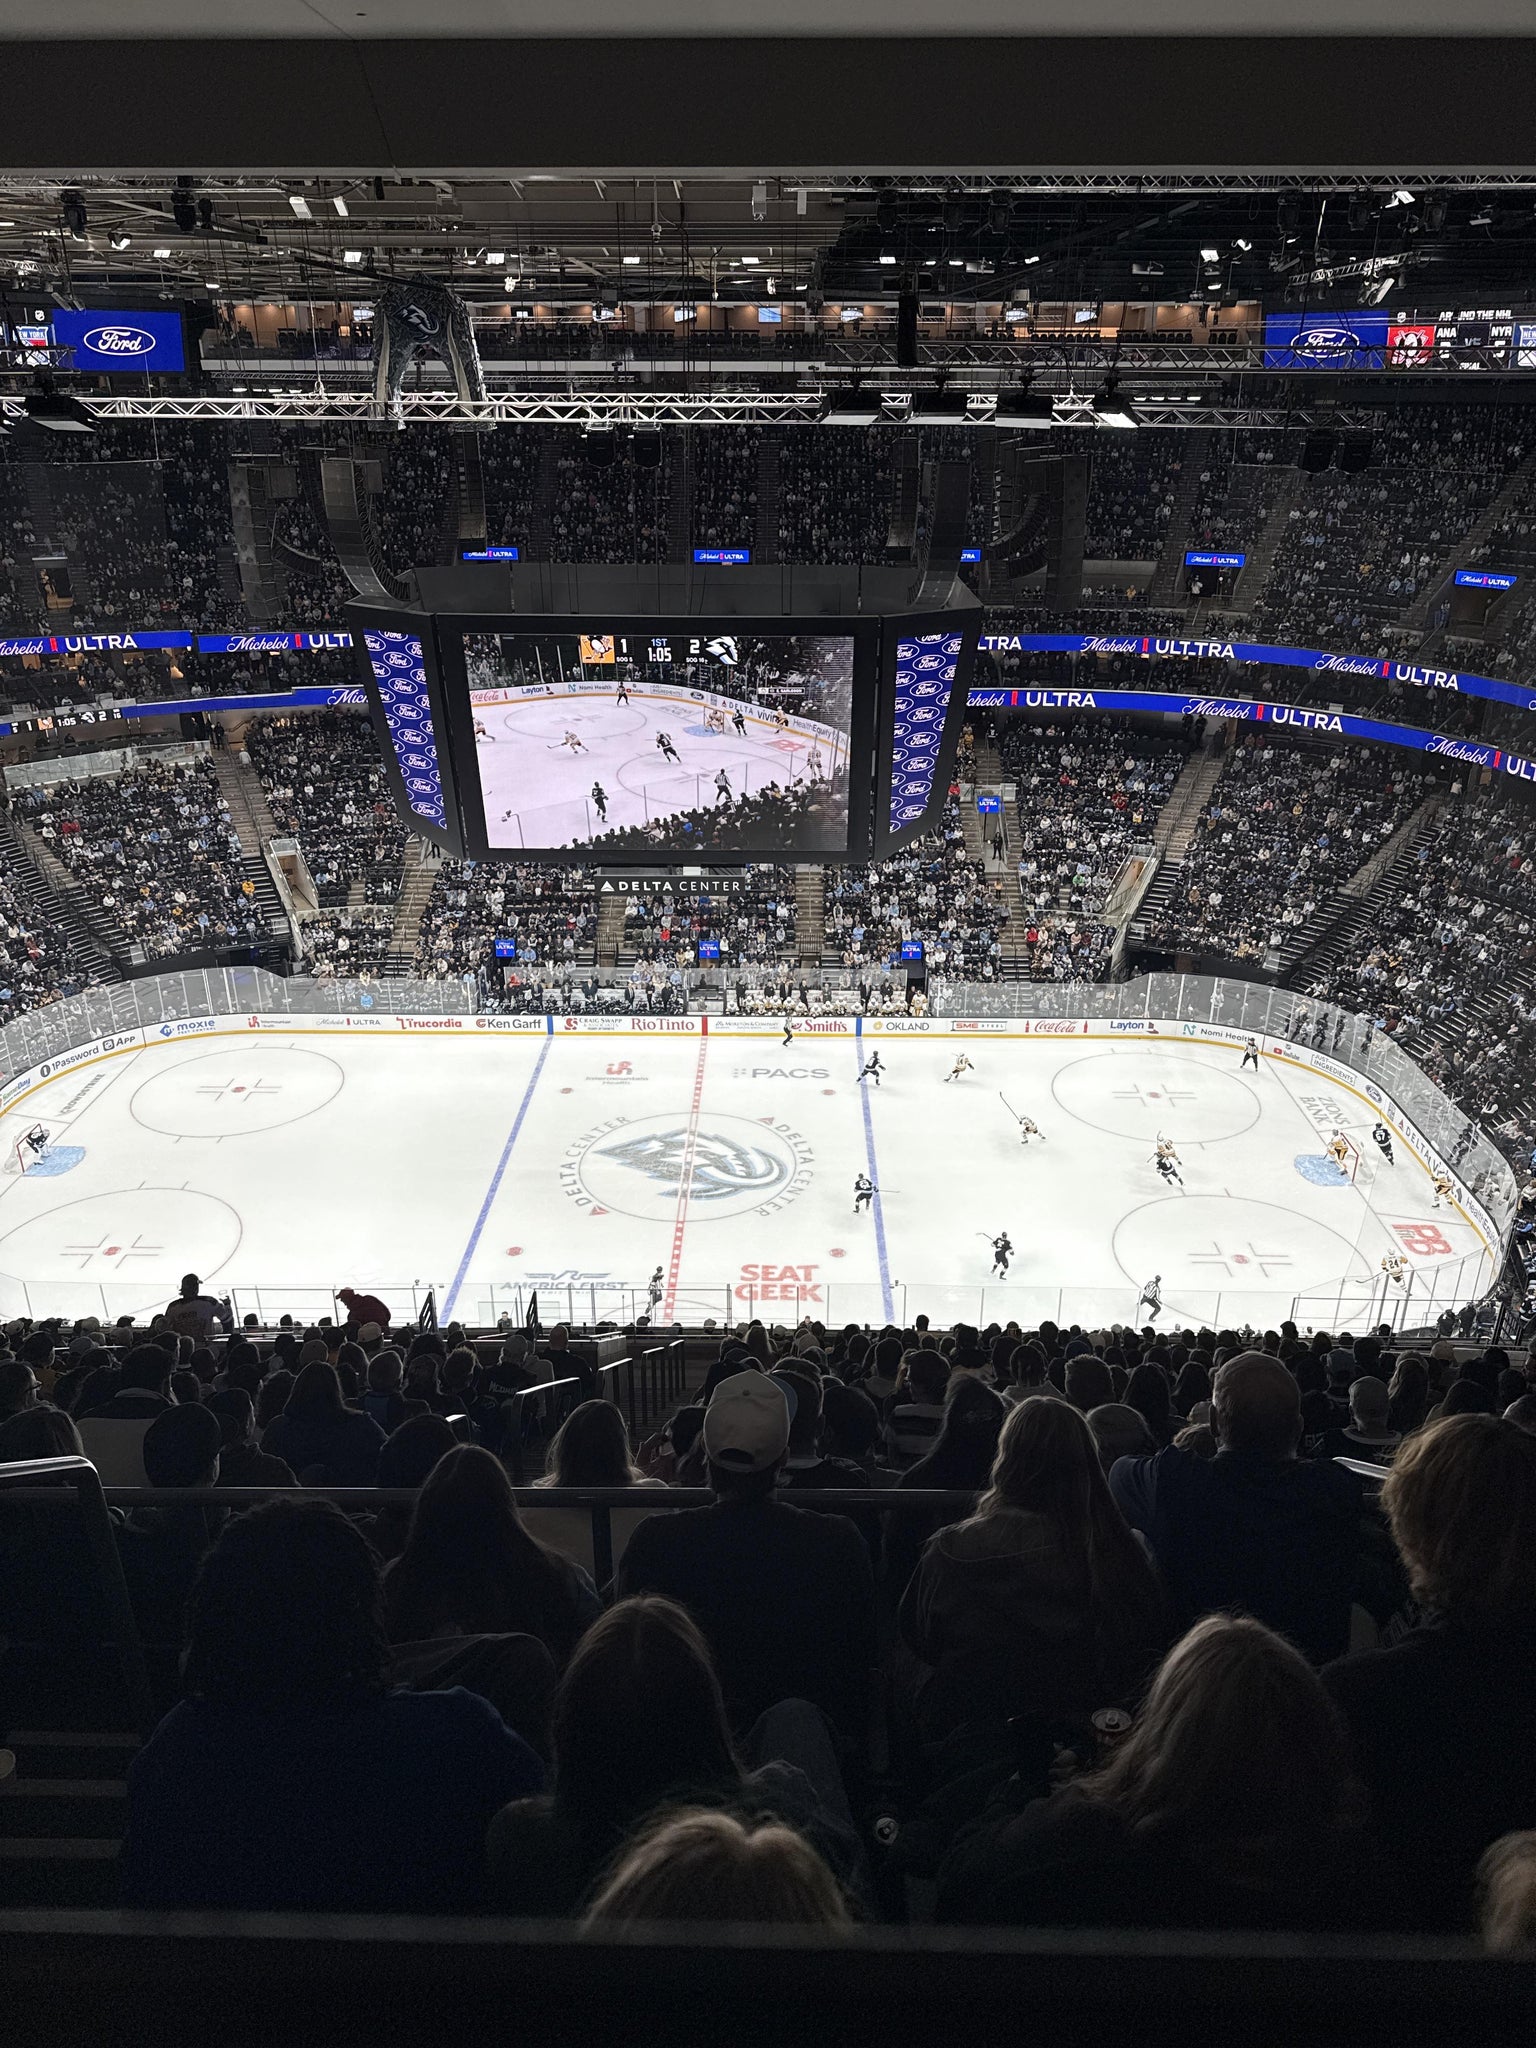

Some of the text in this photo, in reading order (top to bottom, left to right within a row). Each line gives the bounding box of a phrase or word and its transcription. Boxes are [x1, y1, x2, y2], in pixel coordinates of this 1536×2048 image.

[1476, 310, 1494, 320] THE
[1495, 310, 1513, 320] NHL
[28, 330, 44, 338] YORK
[1437, 327, 1456, 338] ANA
[1491, 326, 1512, 336] NYR
[98, 330, 142, 351] Ford
[1488, 578, 1510, 586] ULTRA
[64, 634, 138, 651] ULTRA
[226, 634, 354, 652] Michelob ULT
[620, 638, 628, 654] 1
[650, 638, 668, 646] 1ST
[690, 639, 700, 654] 2
[1080, 636, 1136, 652] Michelob
[389, 654, 408, 666] Ford
[648, 647, 672, 662] 1:05
[919, 656, 940, 668] Ford
[1315, 654, 1459, 690] Michelob ULTRA
[394, 680, 412, 692] Ford
[522, 686, 544, 695] Layton
[916, 684, 936, 694] Ford
[1026, 692, 1096, 708] ULTRA
[398, 706, 417, 718] Ford
[728, 701, 754, 716] DELTA
[913, 709, 934, 720] Ford
[26, 721, 32, 731] 1
[57, 718, 76, 727] 1:05
[98, 711, 106, 721] 2
[1182, 698, 1343, 732] Michelob ULTRA
[404, 730, 422, 742] Ford
[910, 734, 931, 746] Ford
[1426, 736, 1488, 766] Michelob
[408, 756, 426, 767] Ford
[908, 759, 928, 770] Ford
[412, 780, 432, 791] Ford
[905, 783, 926, 794] Ford
[417, 804, 436, 815] Ford
[902, 807, 924, 818] Ford
[618, 881, 740, 891] DELTA CENTER
[177, 1020, 216, 1032] moxie
[406, 1018, 462, 1028] Trucordia
[488, 1018, 542, 1029] Ken Garff
[804, 1019, 848, 1032] Smith's
[886, 1022, 930, 1031] OKLAND
[1110, 1020, 1144, 1031] Layton
[1200, 1028, 1223, 1038] Nomi
[51, 1046, 100, 1071] 1Password
[752, 1068, 830, 1078] PACS
[1314, 1060, 1354, 1082] INGREDIENTS
[1299, 1096, 1332, 1124] BANK
[1317, 1096, 1351, 1125] ZIONS
[1405, 1126, 1430, 1160] DELTA
[560, 1115, 632, 1208] DELTA CENTER
[754, 1124, 815, 1217] DELTA CENTER
[1388, 1259, 1400, 1269] 24
[740, 1263, 819, 1282] SEAT
[580, 1282, 630, 1290] FIRST
[734, 1284, 824, 1303] GEEK
